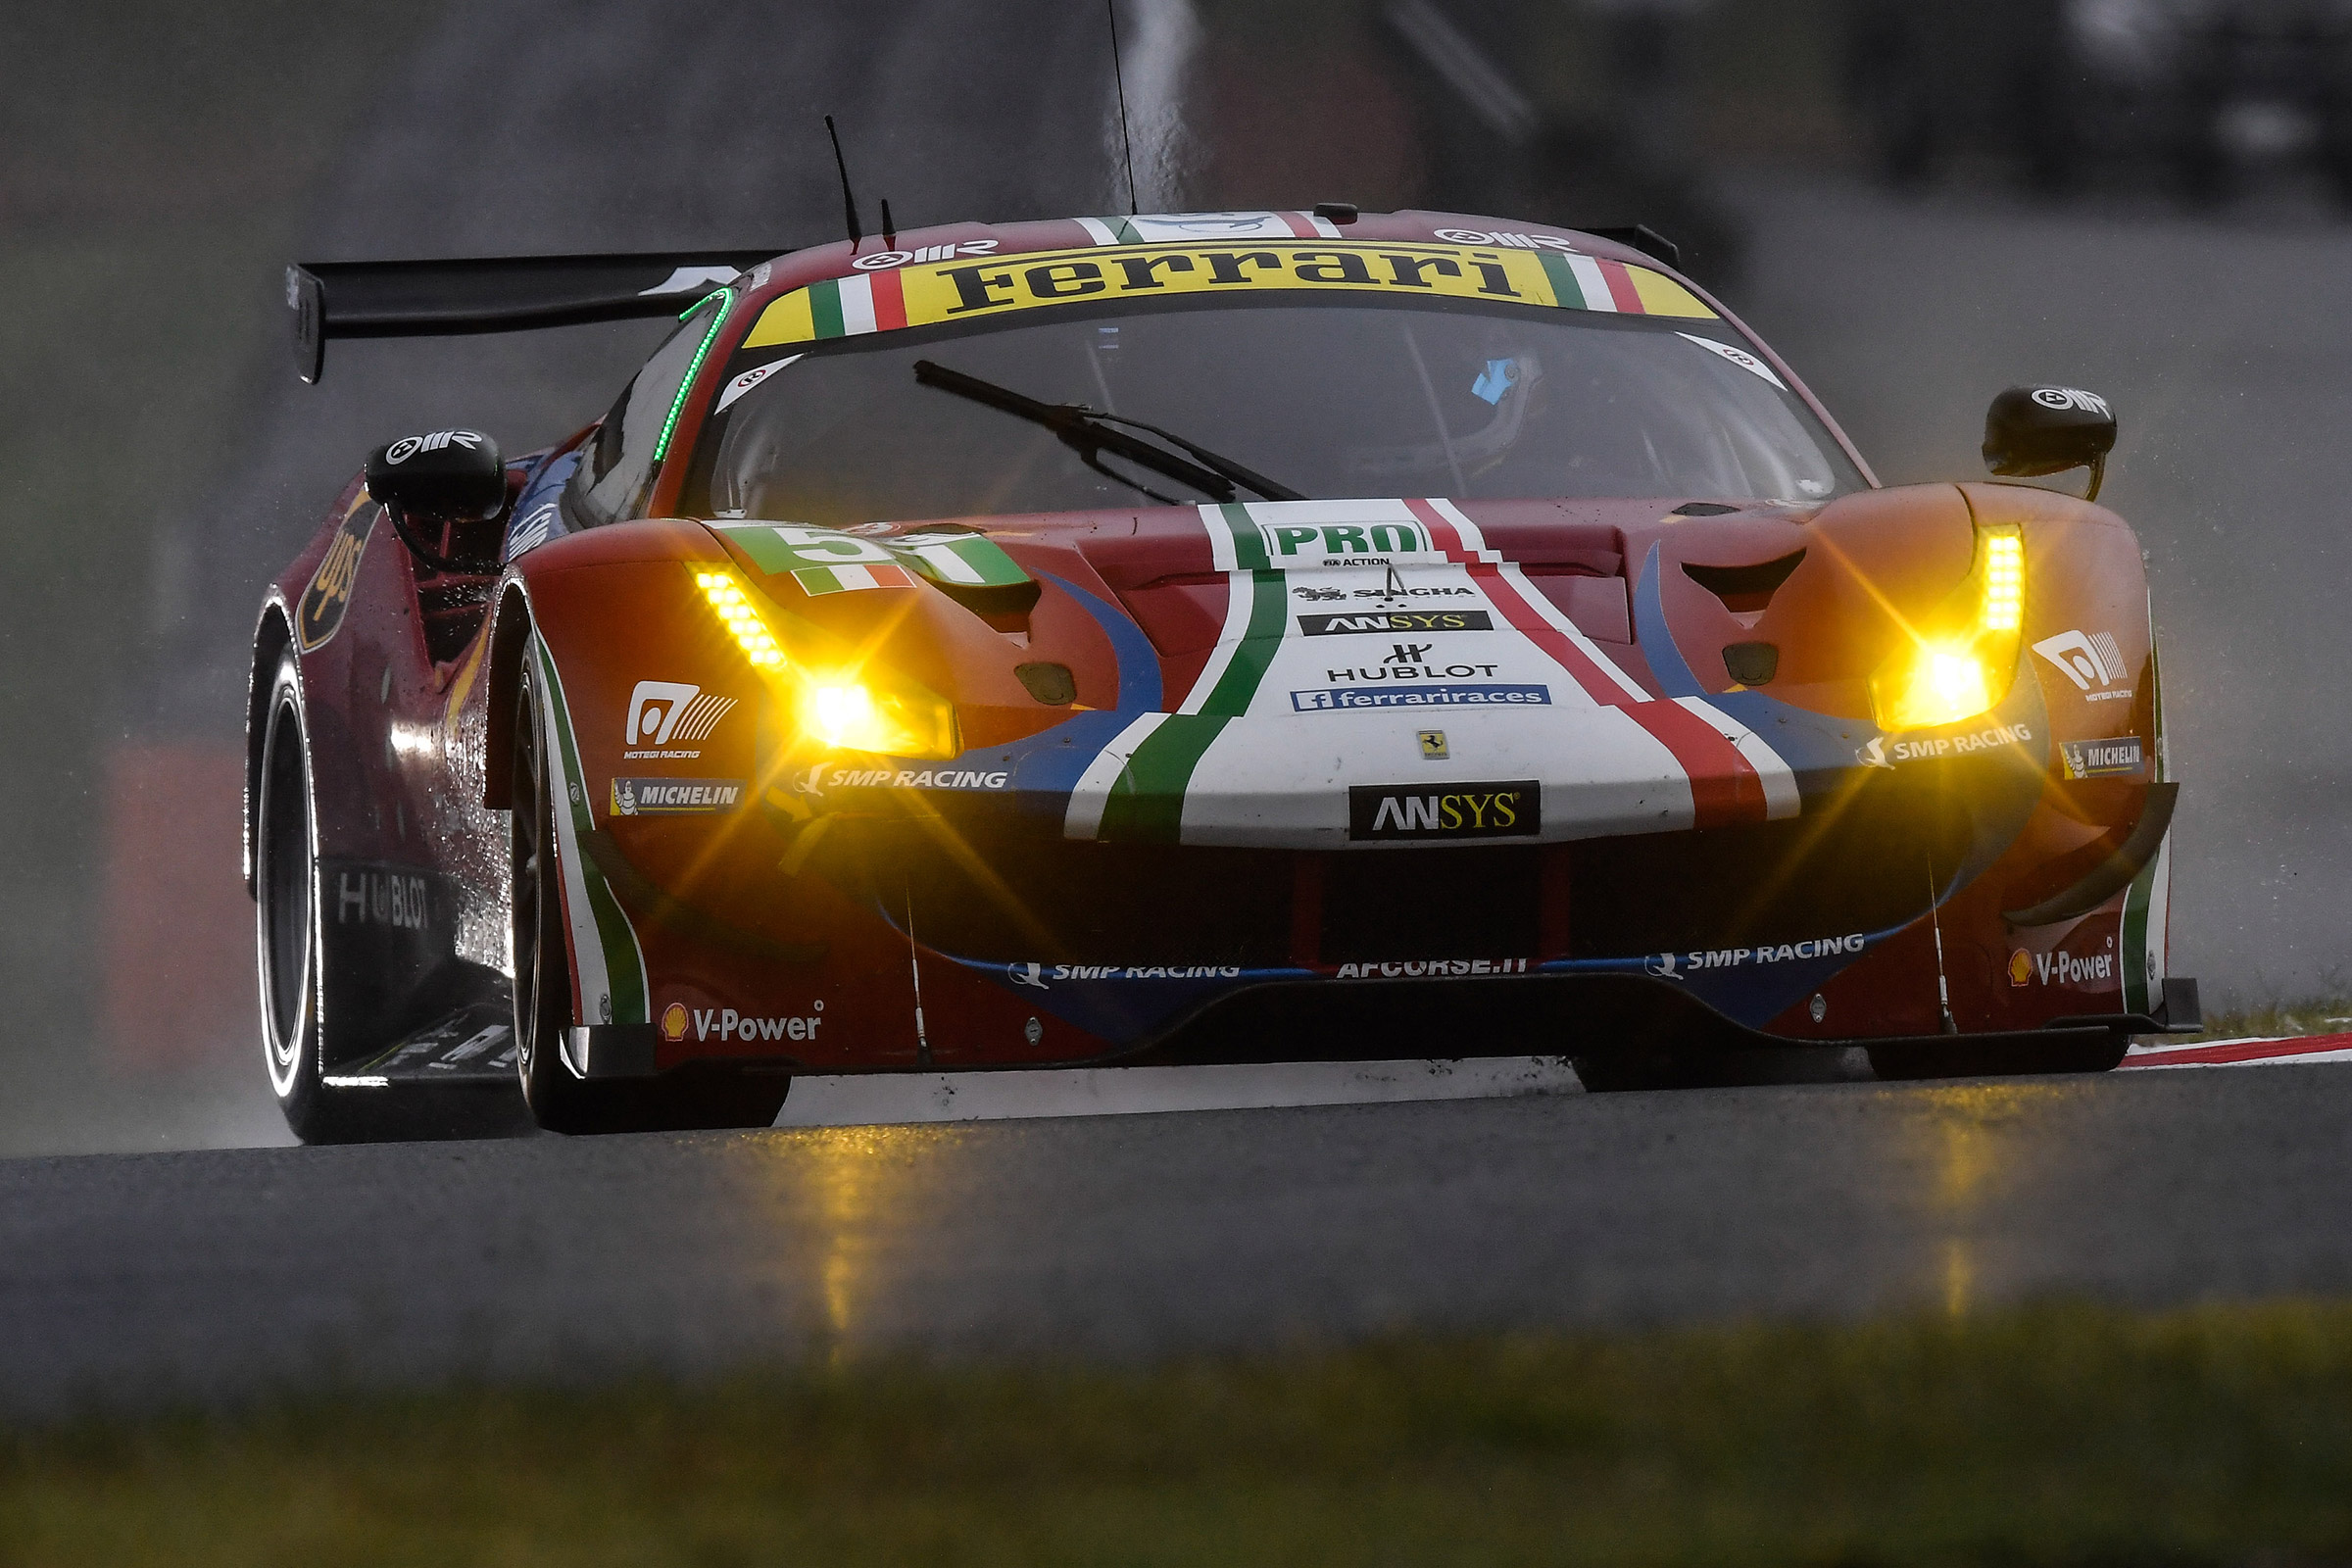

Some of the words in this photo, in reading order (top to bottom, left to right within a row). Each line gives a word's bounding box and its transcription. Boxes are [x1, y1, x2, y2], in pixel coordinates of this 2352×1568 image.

[936, 244, 1522, 315] Ferrari
[1274, 523, 1418, 556] PRO
[1343, 558, 1391, 566] ACTION
[1353, 587, 1475, 598] SINGHA
[1325, 613, 1466, 632] ANSYS
[1327, 663, 1498, 682] HUBLOT
[1339, 687, 1543, 709] ferrariraces
[1893, 739, 1950, 761] SMP
[1956, 723, 2032, 753] RACING
[623, 751, 660, 760] MOTEGI
[2087, 745, 2140, 766] MICHELIN
[830, 769, 896, 787] SMP
[896, 769, 1008, 788] RACING
[640, 786, 739, 805] MICHELIN
[1372, 792, 1517, 831] ANSYS
[338, 872, 428, 930] HUBLOT
[1687, 949, 1750, 970] SMP
[1756, 933, 1865, 963] RACING
[1053, 964, 1120, 979] SMP
[2035, 951, 2113, 986] V-Power
[693, 1008, 821, 1042] V-Power
